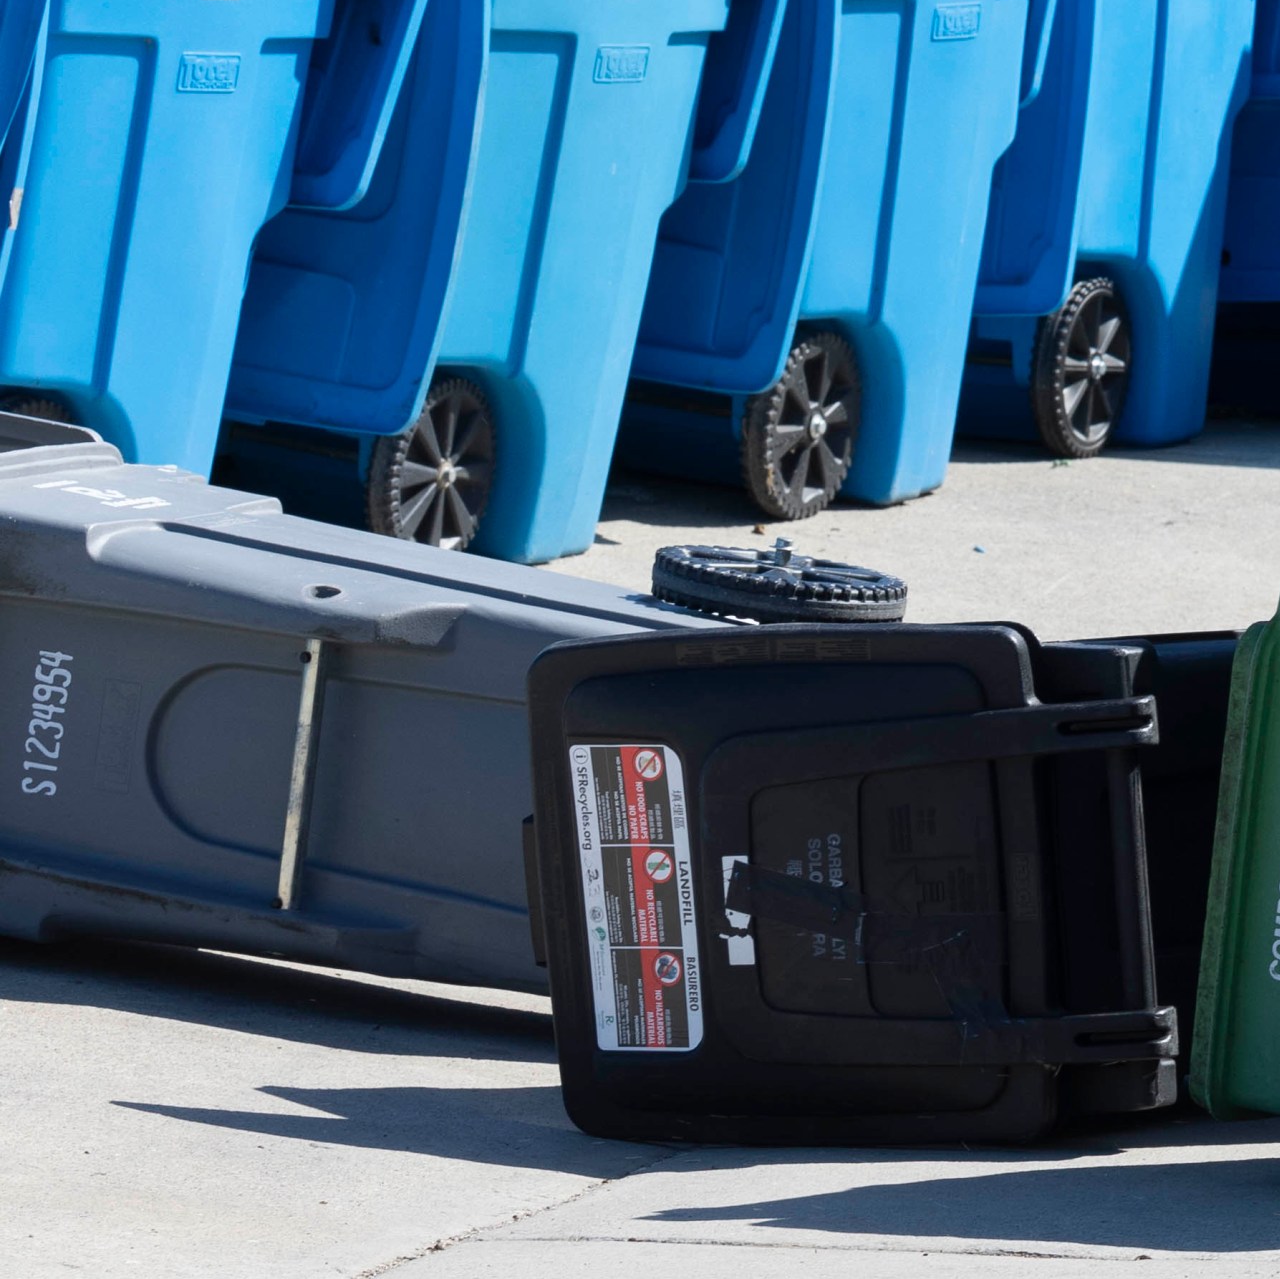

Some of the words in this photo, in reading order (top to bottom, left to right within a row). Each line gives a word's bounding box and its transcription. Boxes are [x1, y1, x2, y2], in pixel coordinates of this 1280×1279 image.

[22, 649, 74, 797] S1234954
[635, 781, 643, 791] NO
[576, 766, 593, 851] SFRecycles.org
[628, 804, 637, 817] NO
[636, 793, 647, 813] FOOD
[630, 817, 640, 840] PAPER
[639, 813, 650, 840] SCRAPS
[645, 889, 654, 900] NO
[678, 860, 693, 926] LANDFILL
[647, 901, 659, 943] RECYCLABLE
[655, 989, 662, 1001] NO
[686, 956, 699, 1012] BASURERO
[656, 1001, 665, 1046] HAZARDOUS
